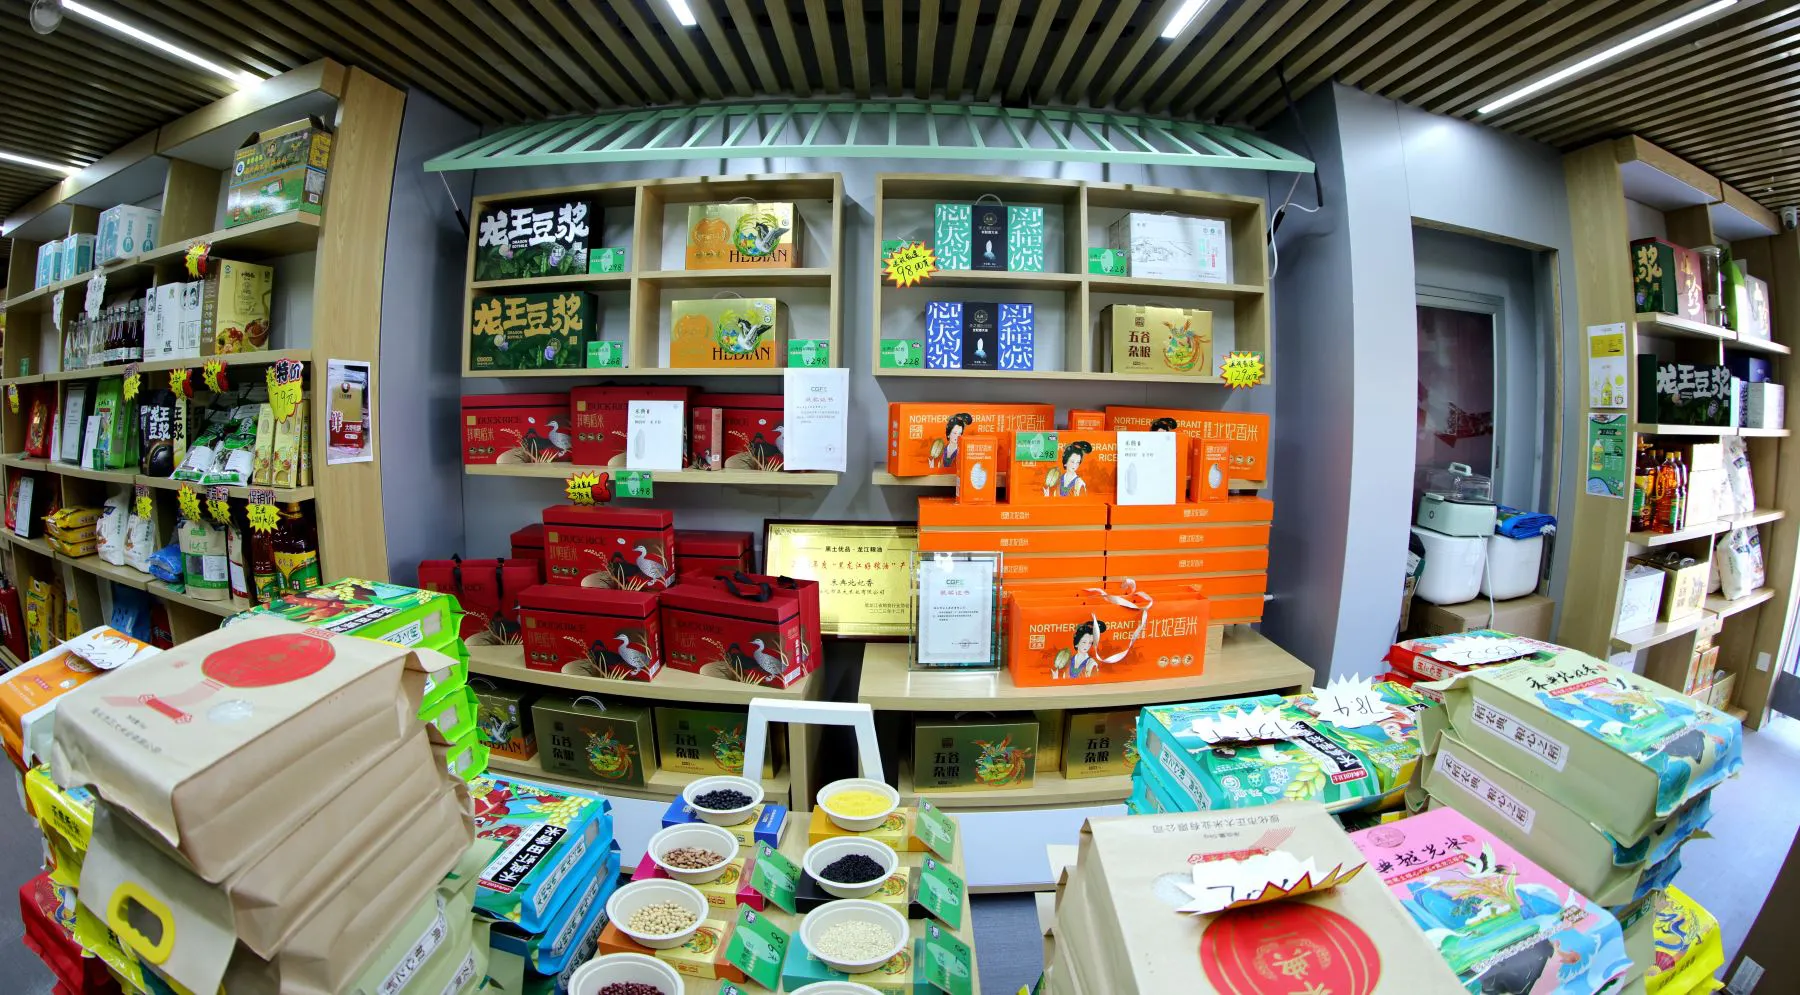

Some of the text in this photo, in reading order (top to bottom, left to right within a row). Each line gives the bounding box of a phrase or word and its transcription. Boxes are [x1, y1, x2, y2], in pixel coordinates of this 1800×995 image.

[478, 201, 589, 246] 龙王豆浆
[472, 293, 582, 337] 龙王豆浆
[1128, 331, 1150, 343] 五谷
[1128, 346, 1150, 357] 杂粮
[276, 361, 300, 383] 特价
[1657, 363, 1731, 399] 龙王豆浆
[970, 414, 995, 423] GRANT
[1008, 414, 1045, 431] 北妃香米
[1176, 420, 1202, 428] GRANT
[977, 425, 995, 433] RICE
[1213, 423, 1258, 441] 北妃香米
[1105, 620, 1135, 631] GRANT
[1148, 616, 1198, 637] 北妃香米
[1087, 737, 1109, 749] 五谷
[934, 752, 959, 764] 五谷
[1085, 751, 1109, 763] 杂粮
[934, 765, 959, 777] 杂粮
[767, 931, 784, 962] ¥9.8
